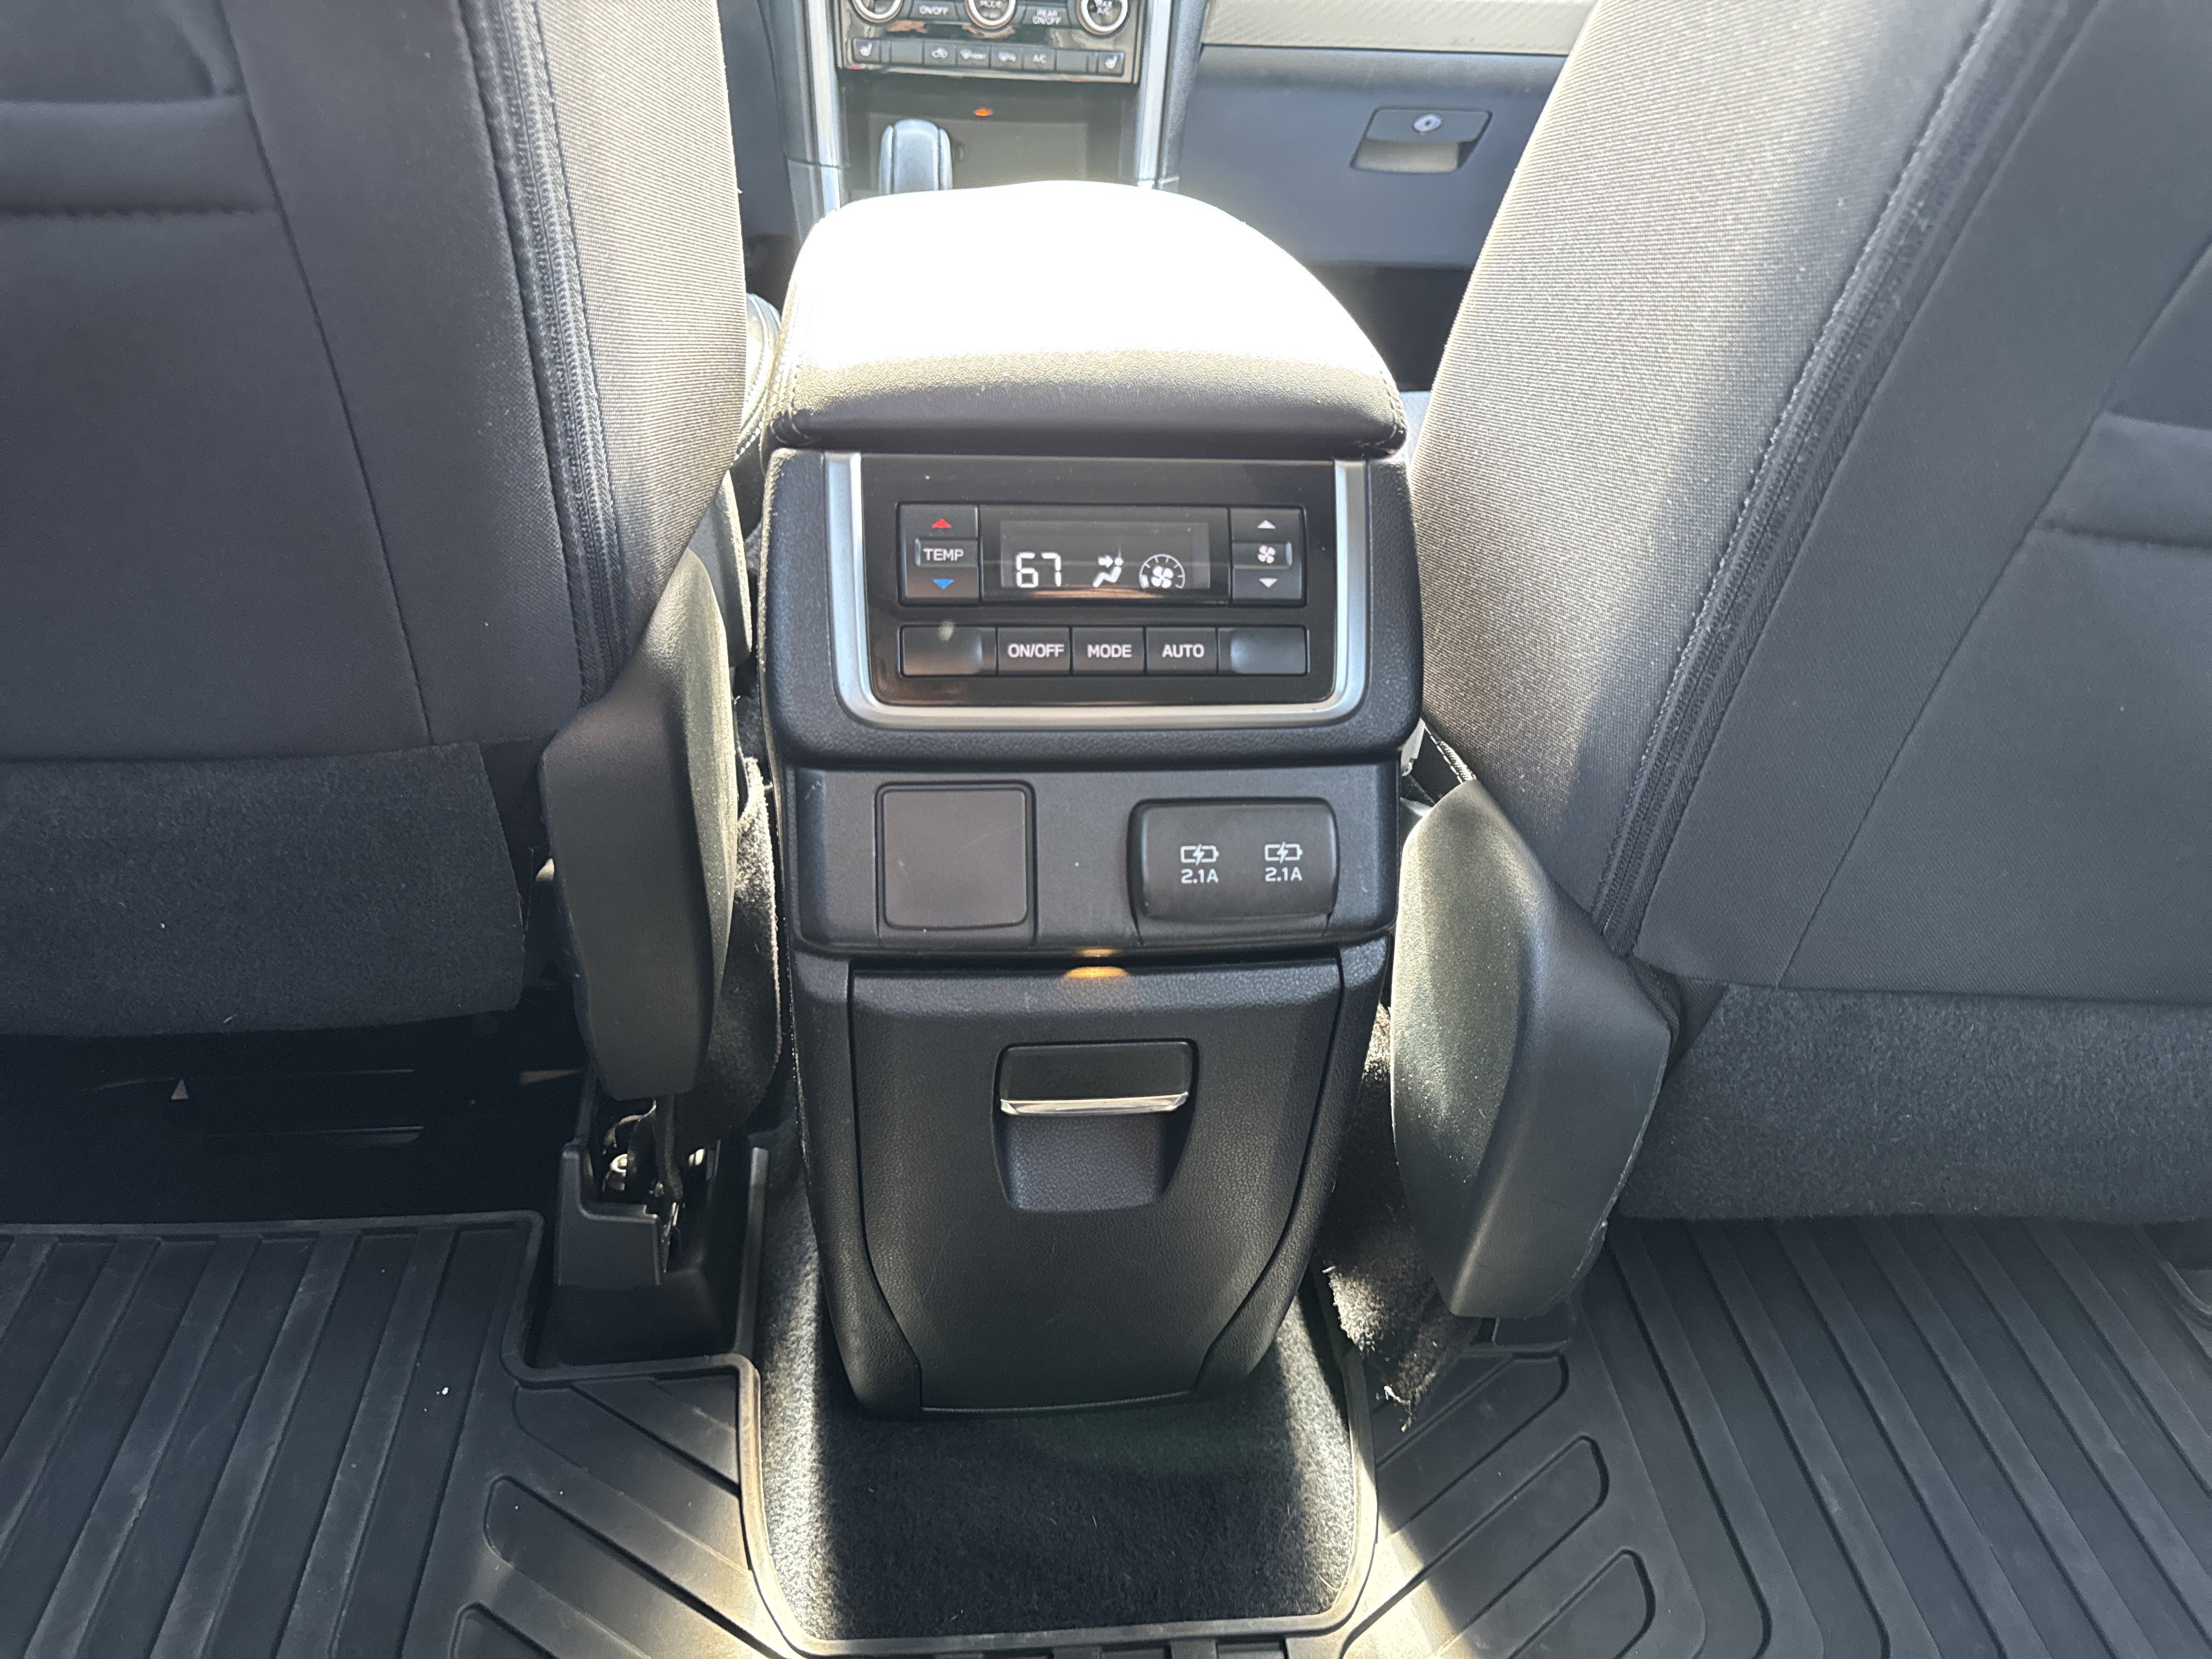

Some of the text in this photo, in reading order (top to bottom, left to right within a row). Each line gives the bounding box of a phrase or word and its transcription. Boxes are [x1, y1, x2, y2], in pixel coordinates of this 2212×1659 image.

[923, 548, 964, 561] TEMP
[1015, 551, 1062, 588] 67
[1008, 643, 1064, 658] ON/OFF
[1087, 644, 1132, 658] MODE
[1162, 644, 1205, 658] AUTO
[1181, 868, 1219, 884] 2.1A
[1265, 867, 1302, 882] 2.1A
